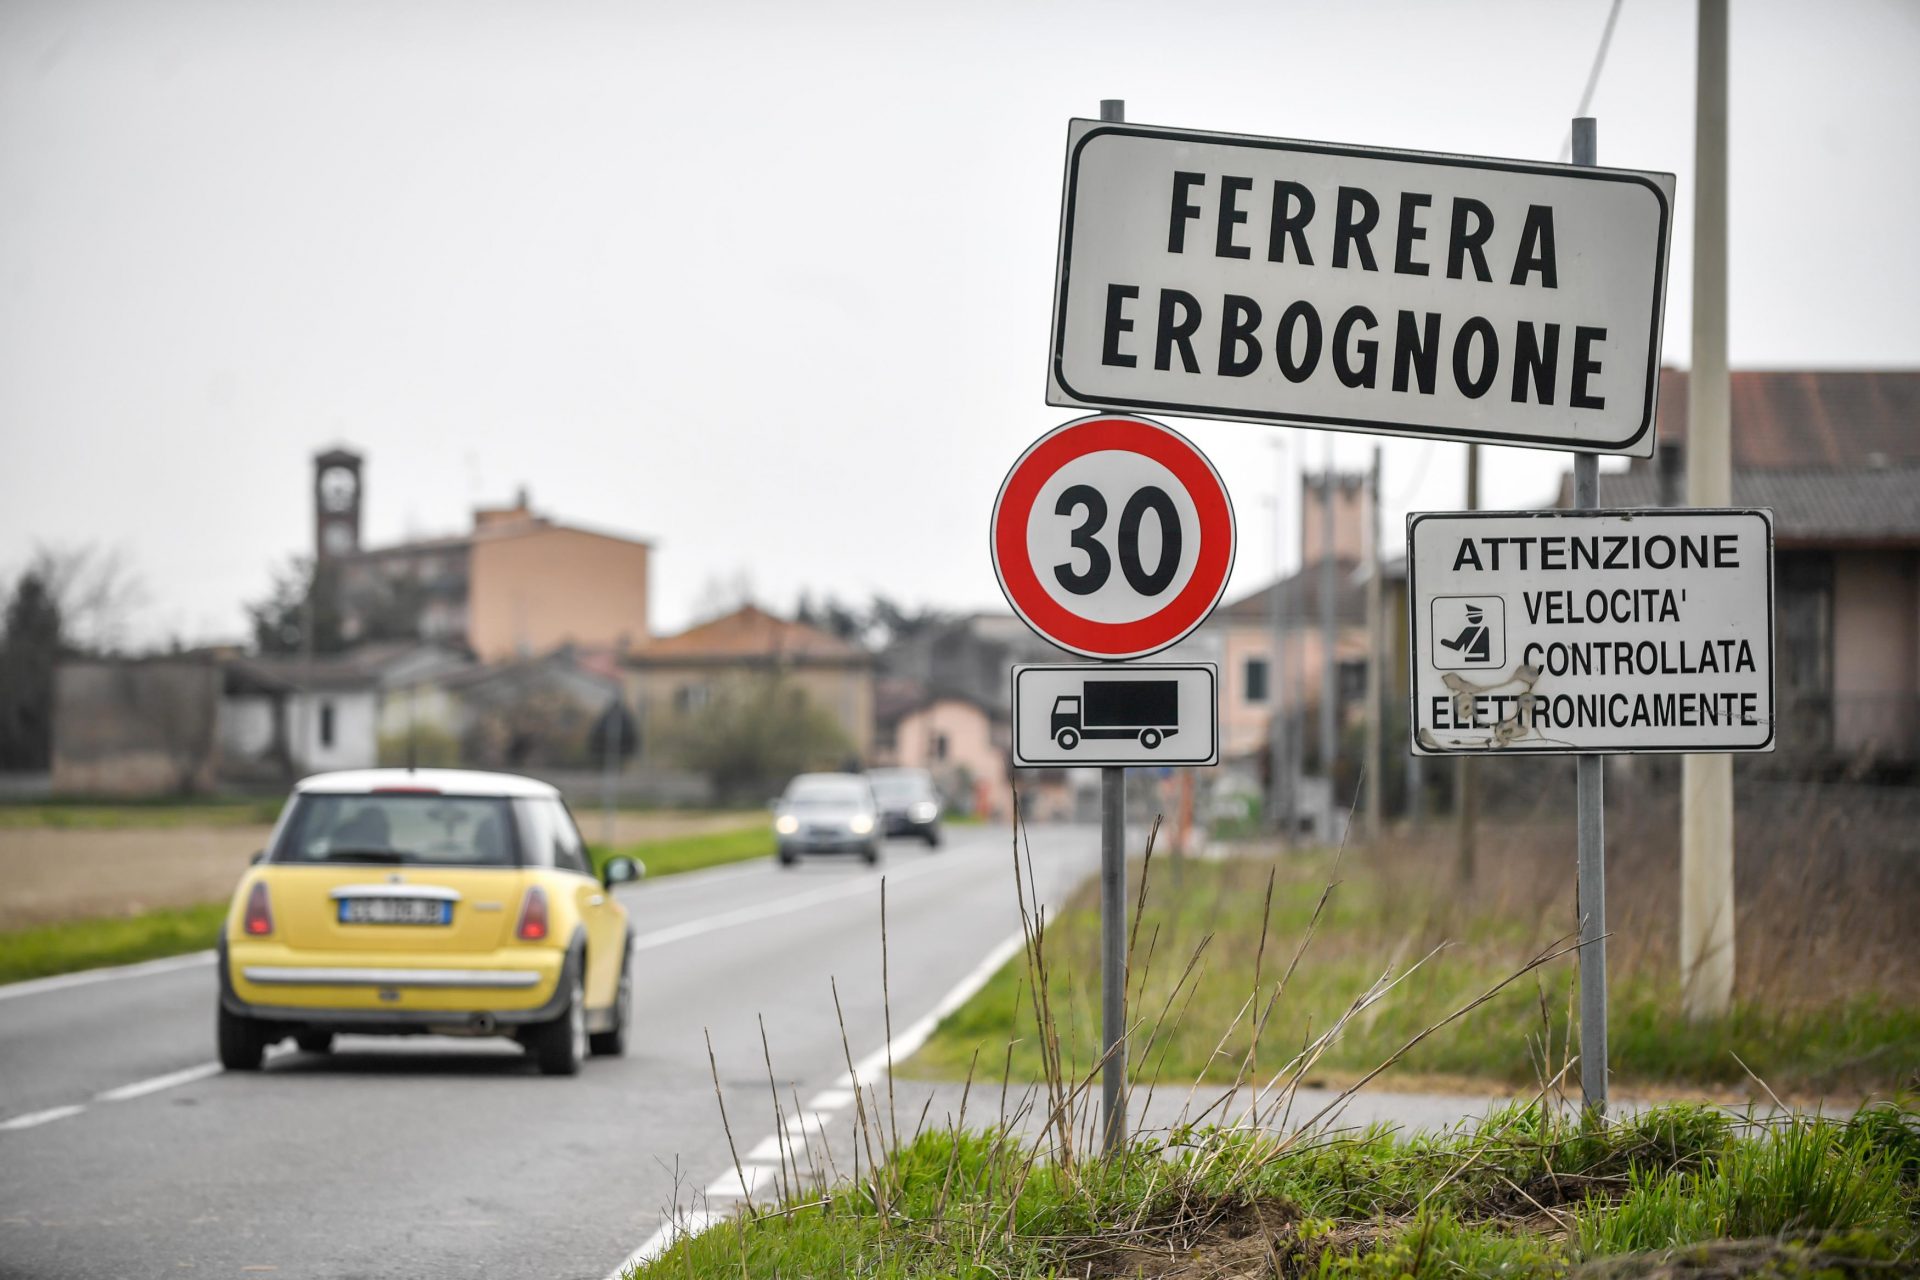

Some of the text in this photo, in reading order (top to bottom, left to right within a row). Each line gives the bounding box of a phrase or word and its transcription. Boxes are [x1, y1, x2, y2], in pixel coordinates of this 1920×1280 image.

[1167, 170, 1558, 290] FERRERA
[1101, 283, 1608, 411] ERBOGNONE
[1053, 484, 1183, 597] 30
[1452, 534, 1740, 572] ATTENZIONE
[1522, 588, 1686, 625] VELOCITA'
[1523, 639, 1757, 677] CONTROLLATA
